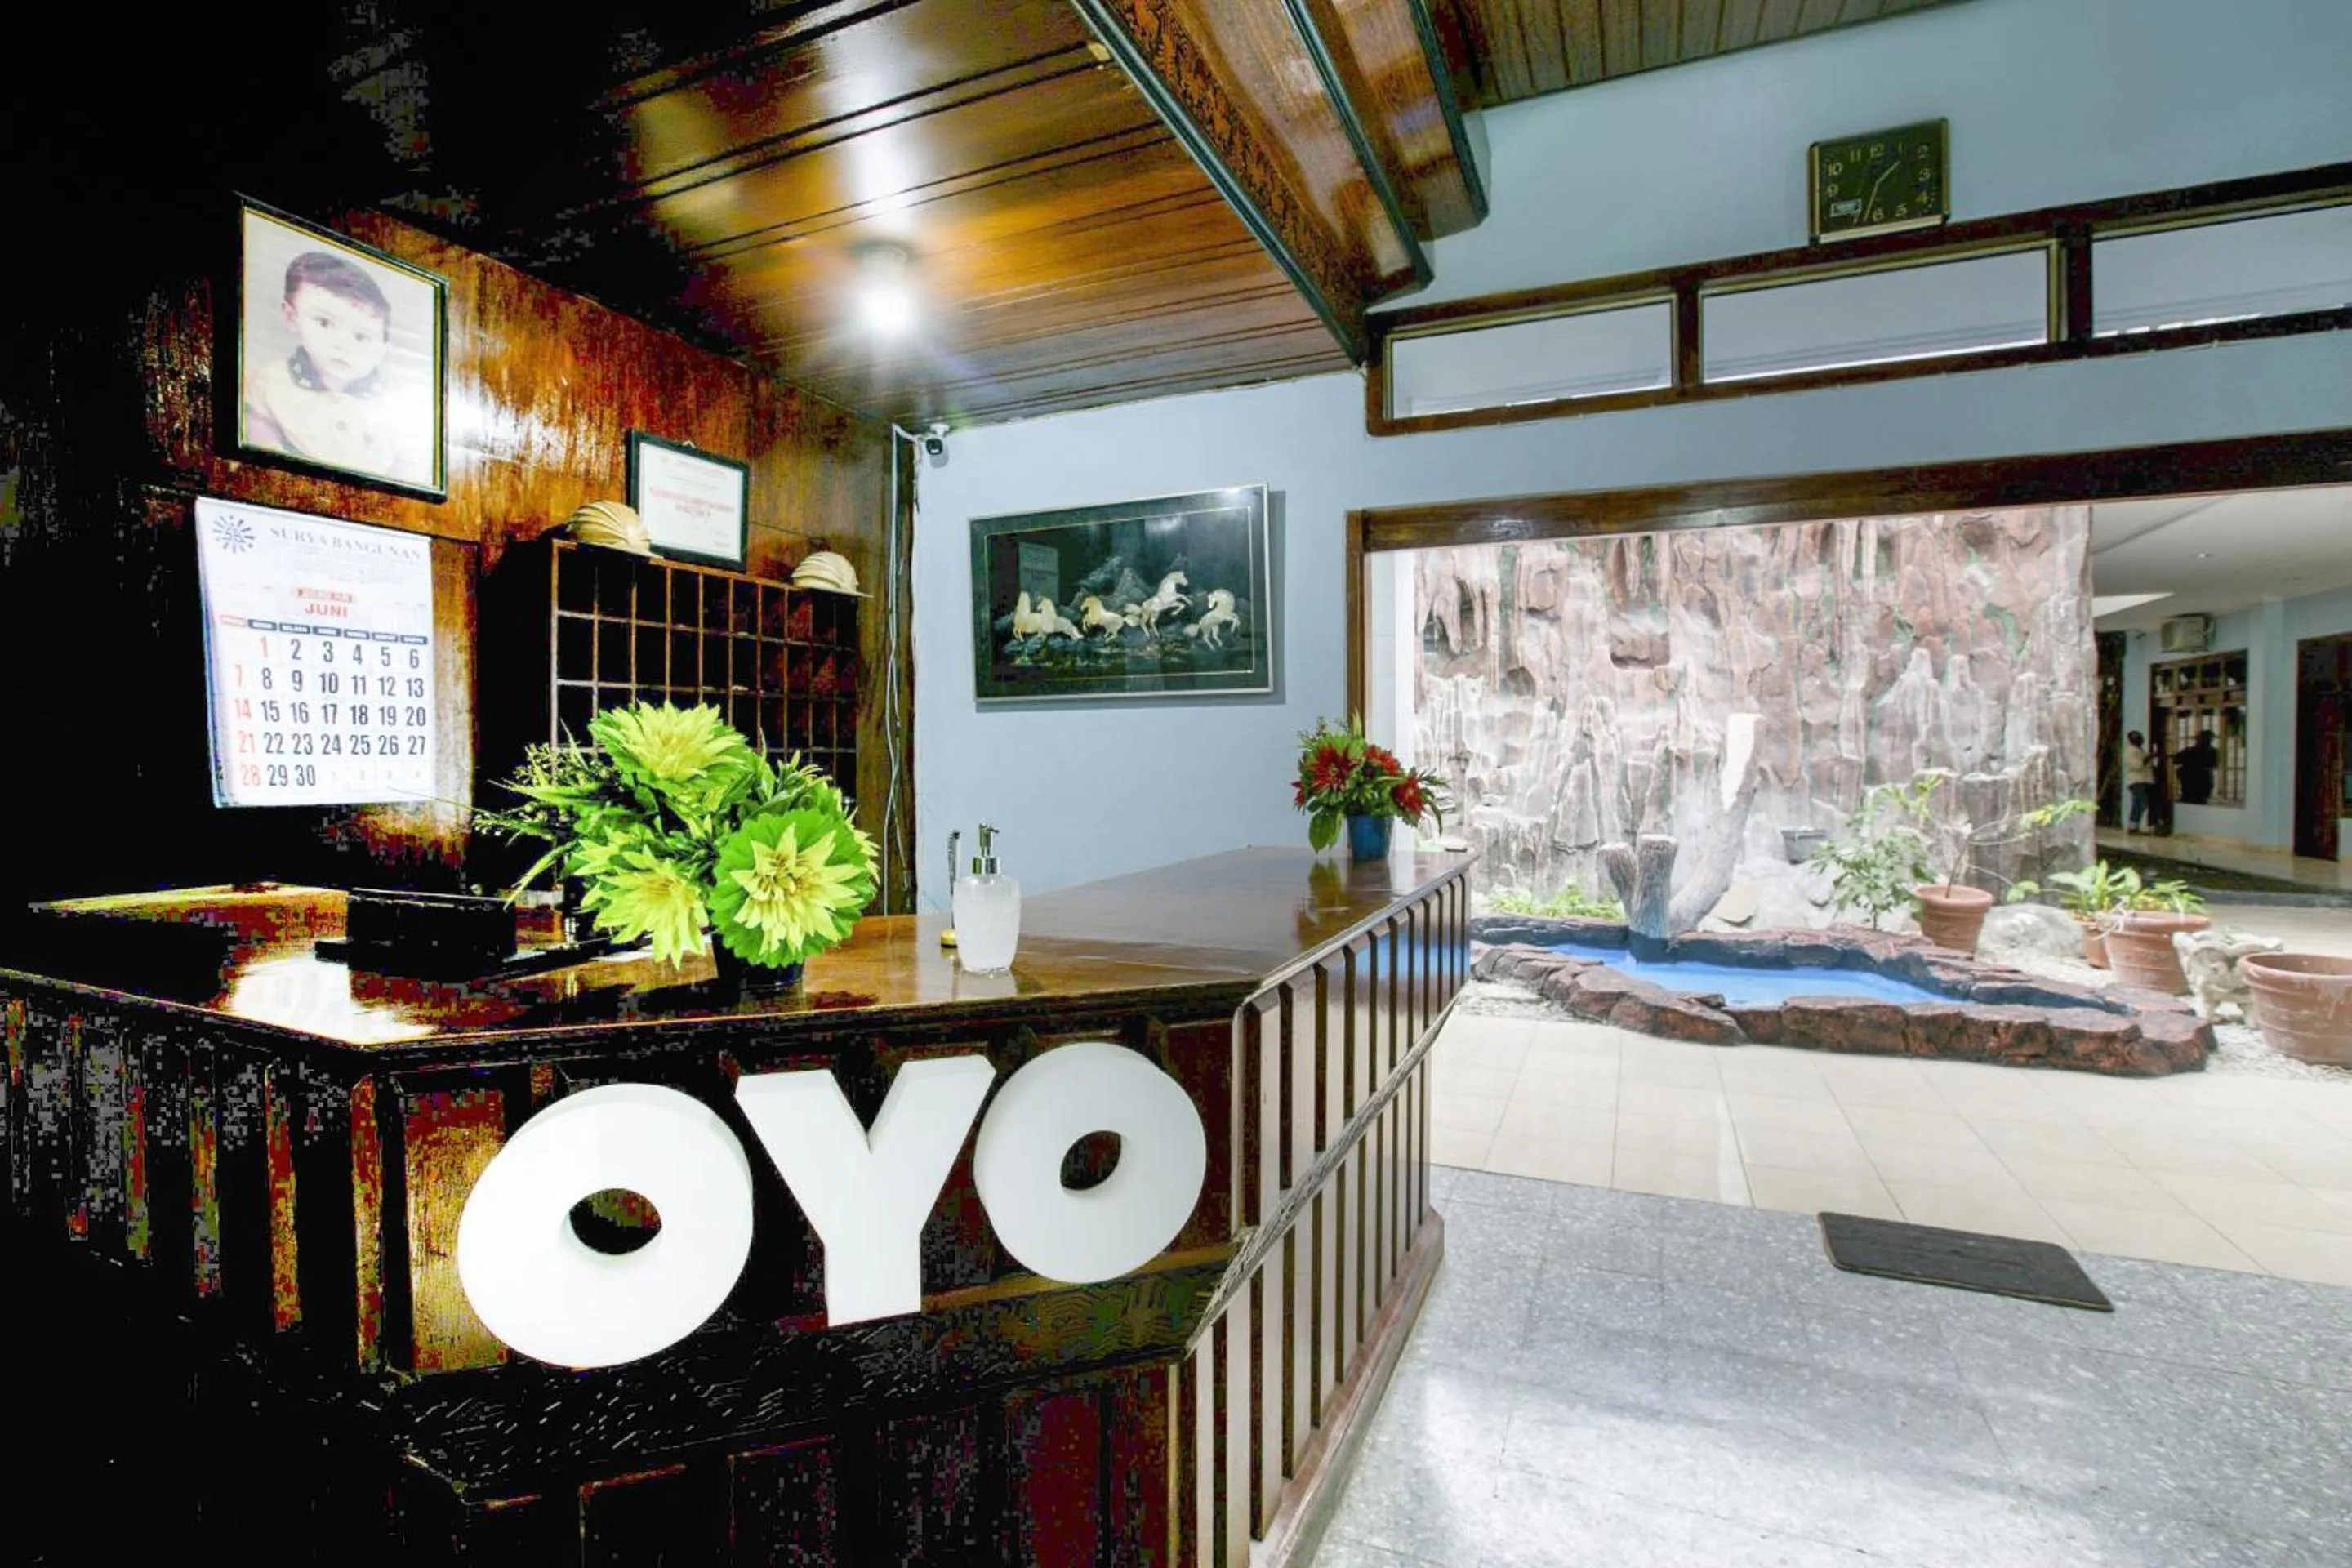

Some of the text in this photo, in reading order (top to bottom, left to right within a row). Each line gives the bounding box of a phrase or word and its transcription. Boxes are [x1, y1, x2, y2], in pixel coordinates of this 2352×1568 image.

[1850, 149, 1861, 163] 11
[1828, 163, 1843, 176] 10
[1873, 208, 1884, 222] 6
[270, 526, 328, 547] SURYA
[305, 604, 348, 618] JUNI
[260, 635, 419, 669] 1 2 3 4 5 6
[234, 664, 424, 697] 7 8 9 10 11 12 13
[235, 699, 426, 727] 14 15 16 17 18 19 20
[238, 731, 425, 755] 21 22 23 24 25 26 27
[241, 764, 261, 786] 28
[267, 764, 287, 786] 29
[295, 764, 316, 786] 30
[457, 1041, 1208, 1369] OYO
